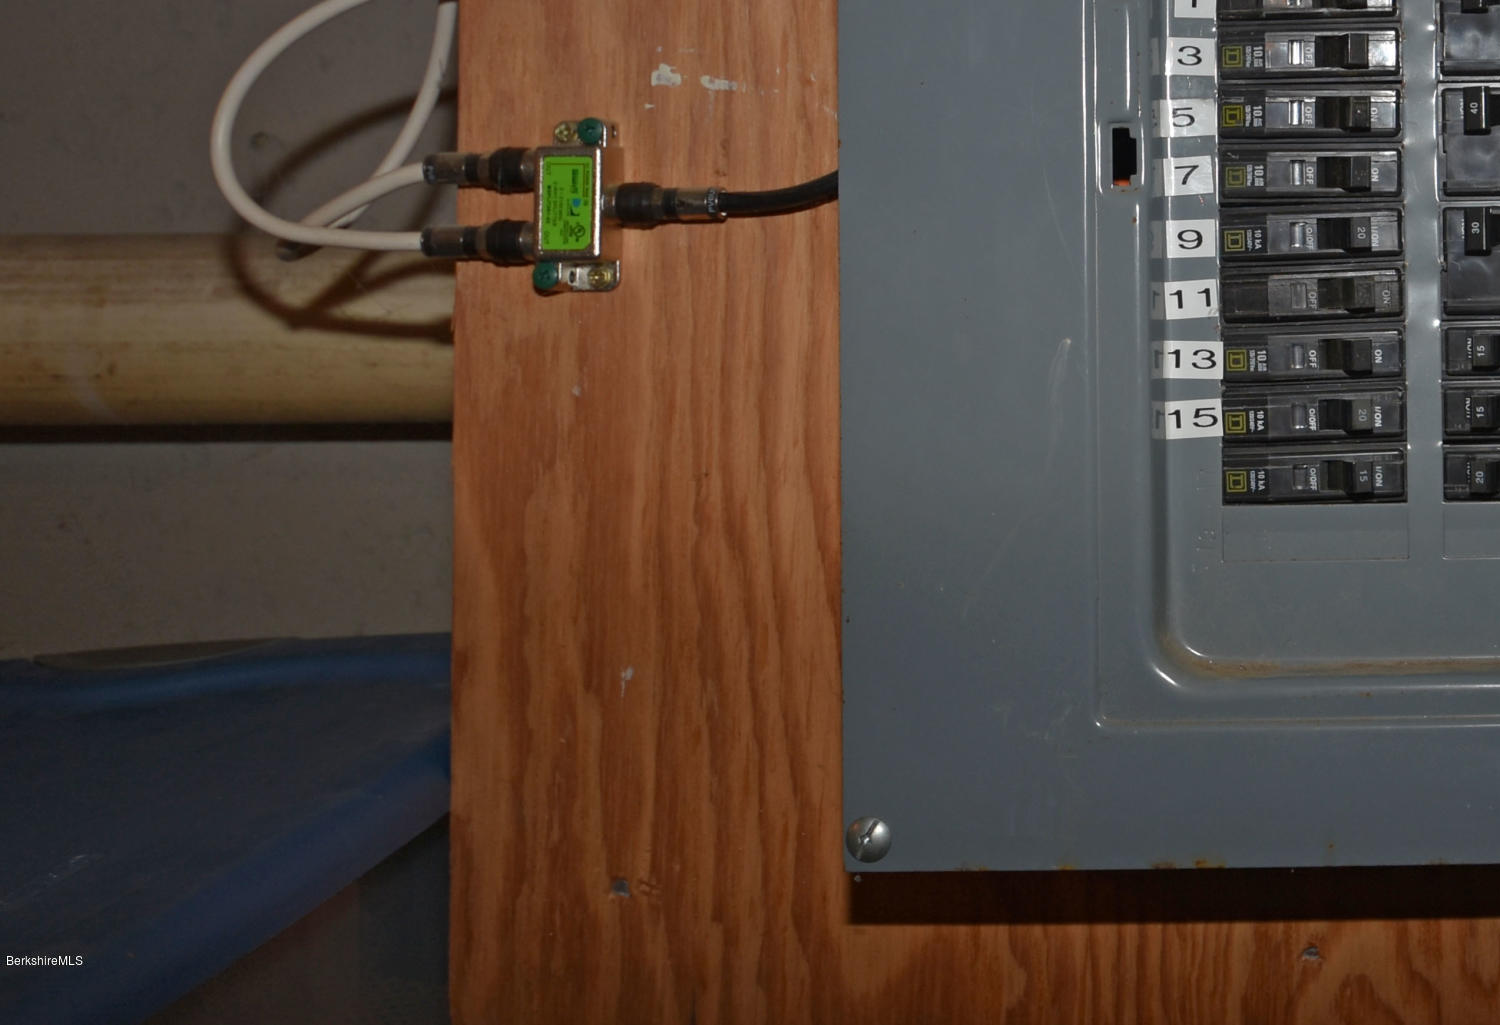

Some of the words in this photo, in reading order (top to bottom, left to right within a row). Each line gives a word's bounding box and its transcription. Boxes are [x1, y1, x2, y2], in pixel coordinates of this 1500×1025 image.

[1177, 46, 1202, 66] 3
[1470, 102, 1478, 114] 40
[1172, 107, 1195, 127] 5
[1174, 165, 1199, 185] 7
[1358, 227, 1366, 240] 20
[1472, 222, 1480, 234] 30
[1177, 230, 1202, 249] 9
[1169, 288, 1211, 309] 11
[1375, 349, 1382, 363] ON
[1477, 346, 1485, 357] 15
[1168, 349, 1217, 369] 13
[1309, 350, 1317, 368] OFF
[1168, 408, 1218, 429] 15
[1358, 408, 1367, 421] 20
[1476, 407, 1484, 418] 15
[1360, 470, 1367, 482] 15
[1476, 471, 1484, 484] 20
